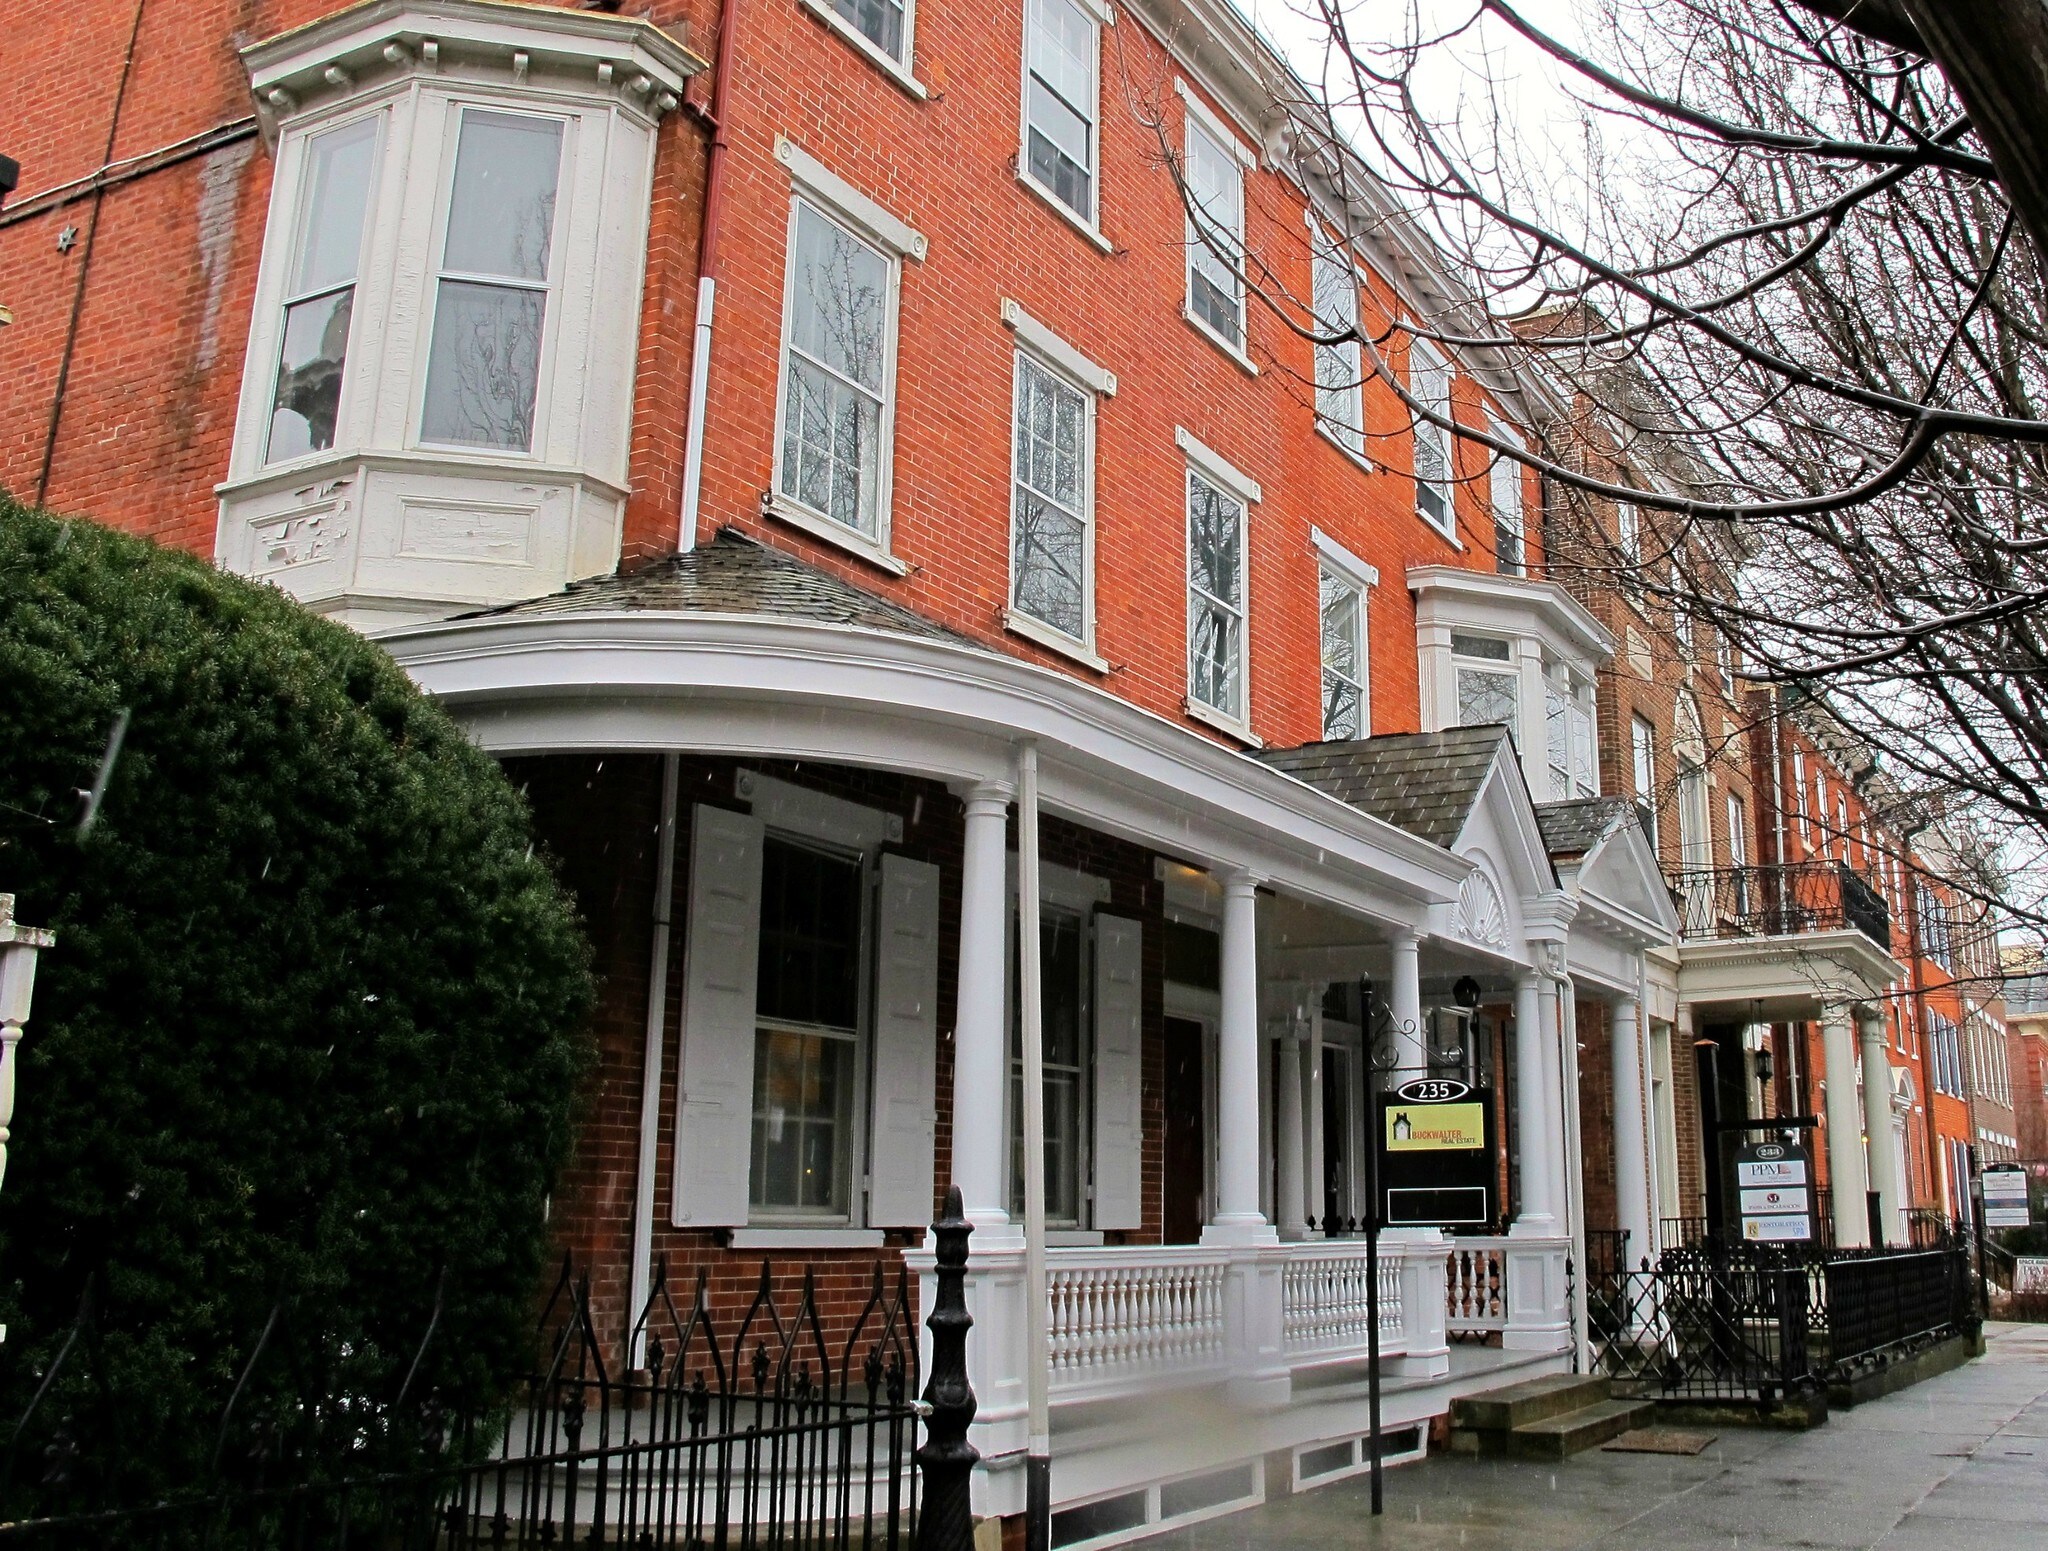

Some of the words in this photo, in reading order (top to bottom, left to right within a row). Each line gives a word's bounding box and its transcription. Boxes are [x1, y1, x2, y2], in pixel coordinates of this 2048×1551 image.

[1418, 1083, 1450, 1099] 235
[1412, 1130, 1462, 1140] BUCKWALTER
[1751, 1164, 1781, 1176] PPM
